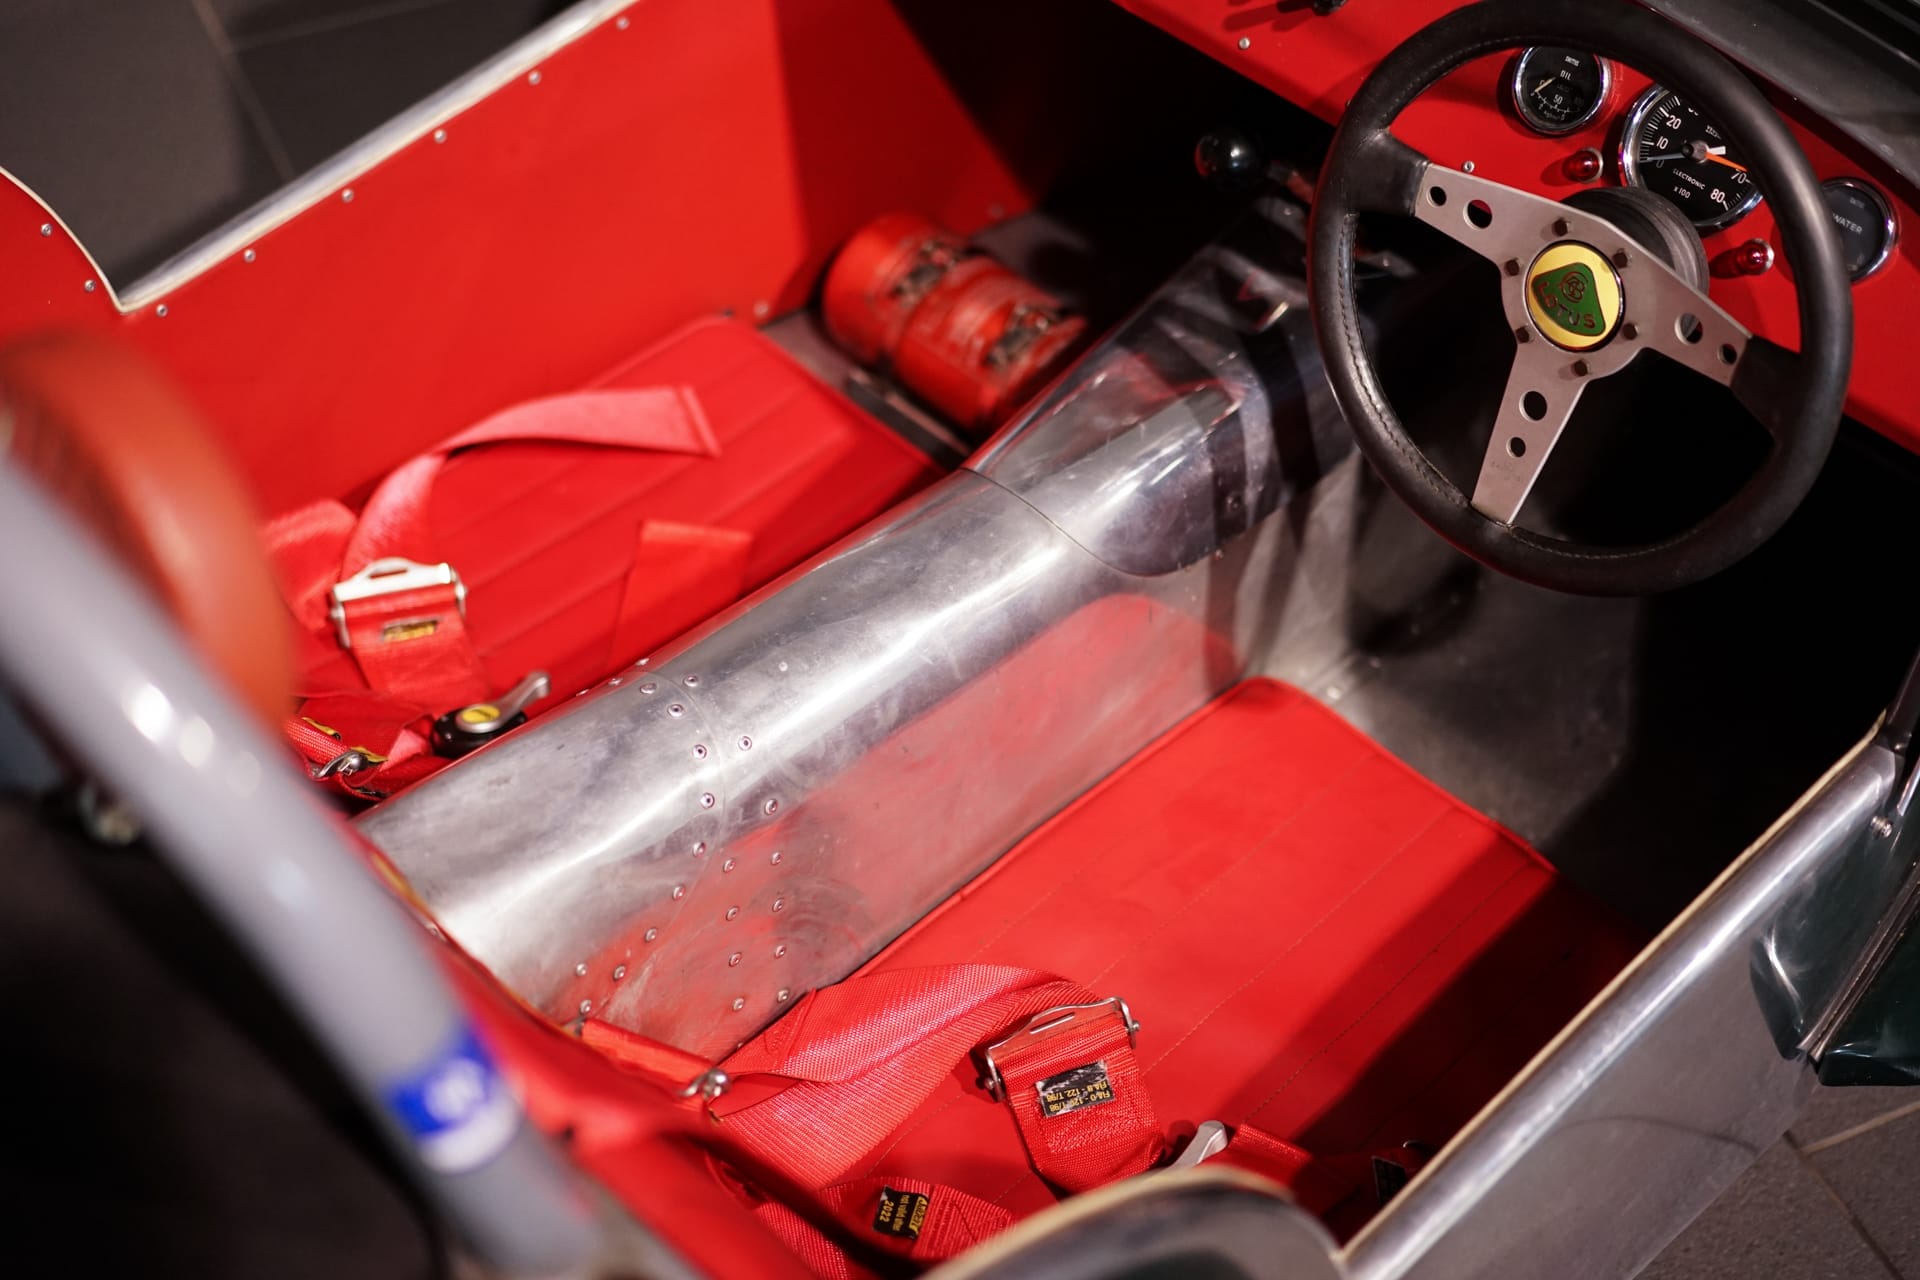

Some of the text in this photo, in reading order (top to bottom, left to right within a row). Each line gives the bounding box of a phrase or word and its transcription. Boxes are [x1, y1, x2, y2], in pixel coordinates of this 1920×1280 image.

[1560, 70, 1572, 80] OIL
[1553, 94, 1563, 105] 50
[1666, 114, 1682, 130] 20
[1656, 136, 1669, 150] 10
[1672, 168, 1706, 190] ELECTRONIC
[1731, 168, 1747, 184] 70
[1710, 188, 1726, 203] 80
[1832, 213, 1863, 234] WATER
[1538, 281, 1596, 329] LOTUS
[880, 1200, 894, 1222] 2022
